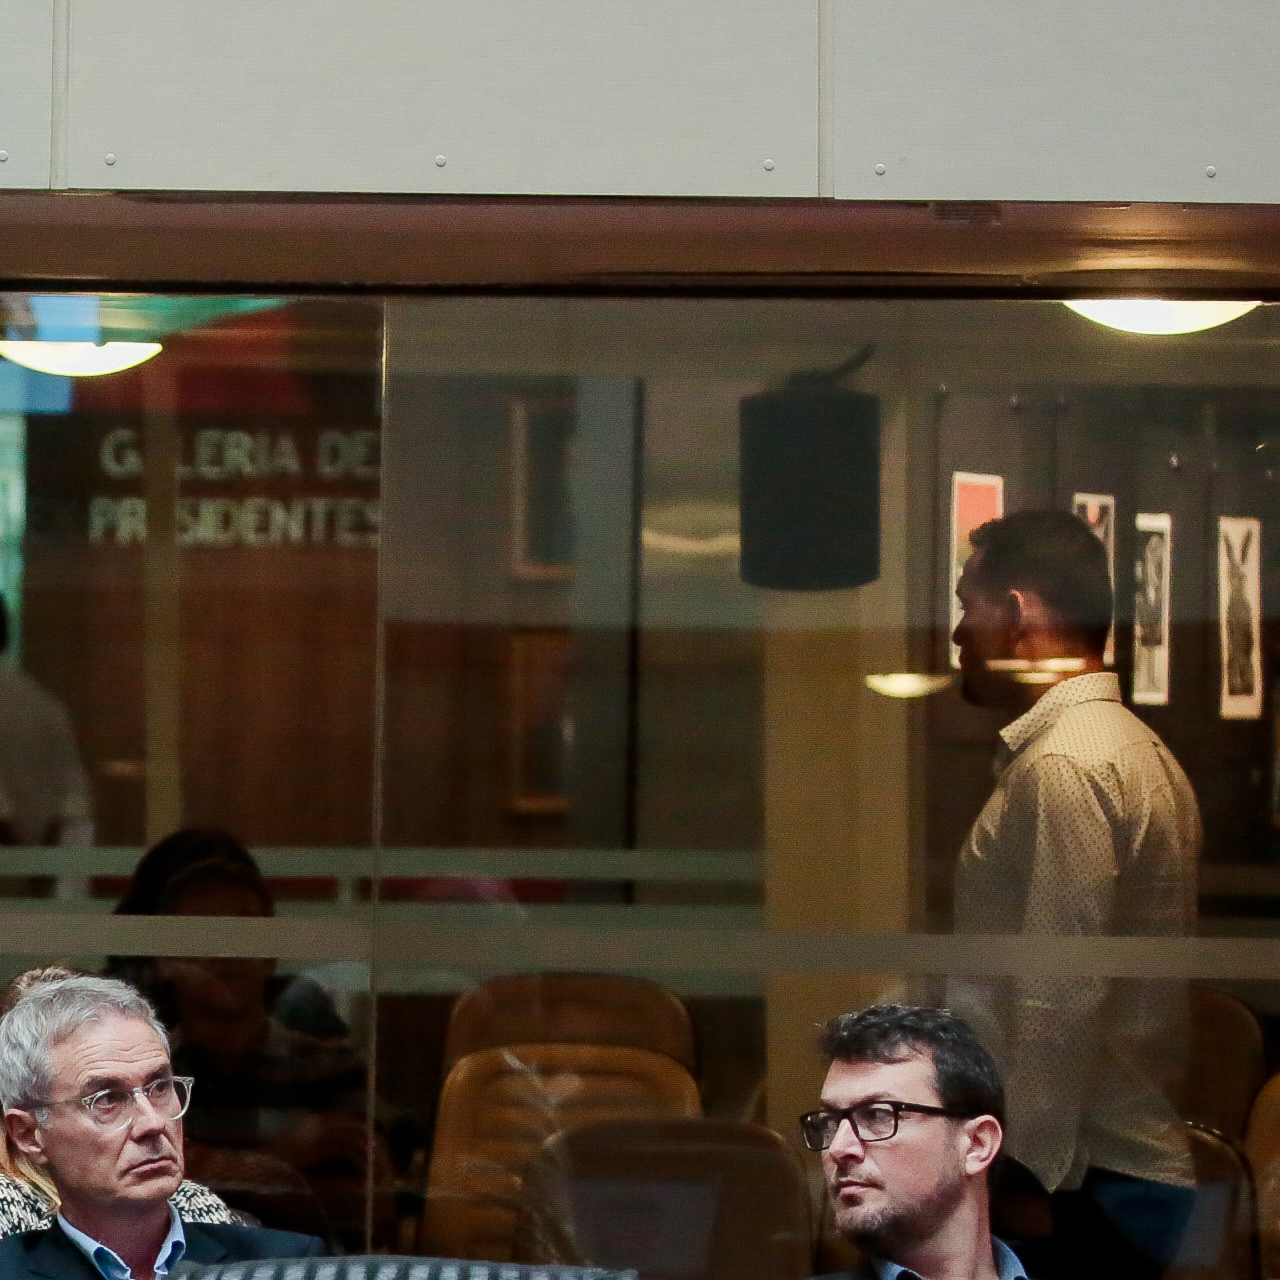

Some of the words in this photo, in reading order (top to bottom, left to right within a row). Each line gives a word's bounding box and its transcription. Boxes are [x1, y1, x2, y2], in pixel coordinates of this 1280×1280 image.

[99, 427, 301, 479] GLERIA
[316, 429, 381, 479] DE
[88, 496, 382, 548] PRSIDENTES
